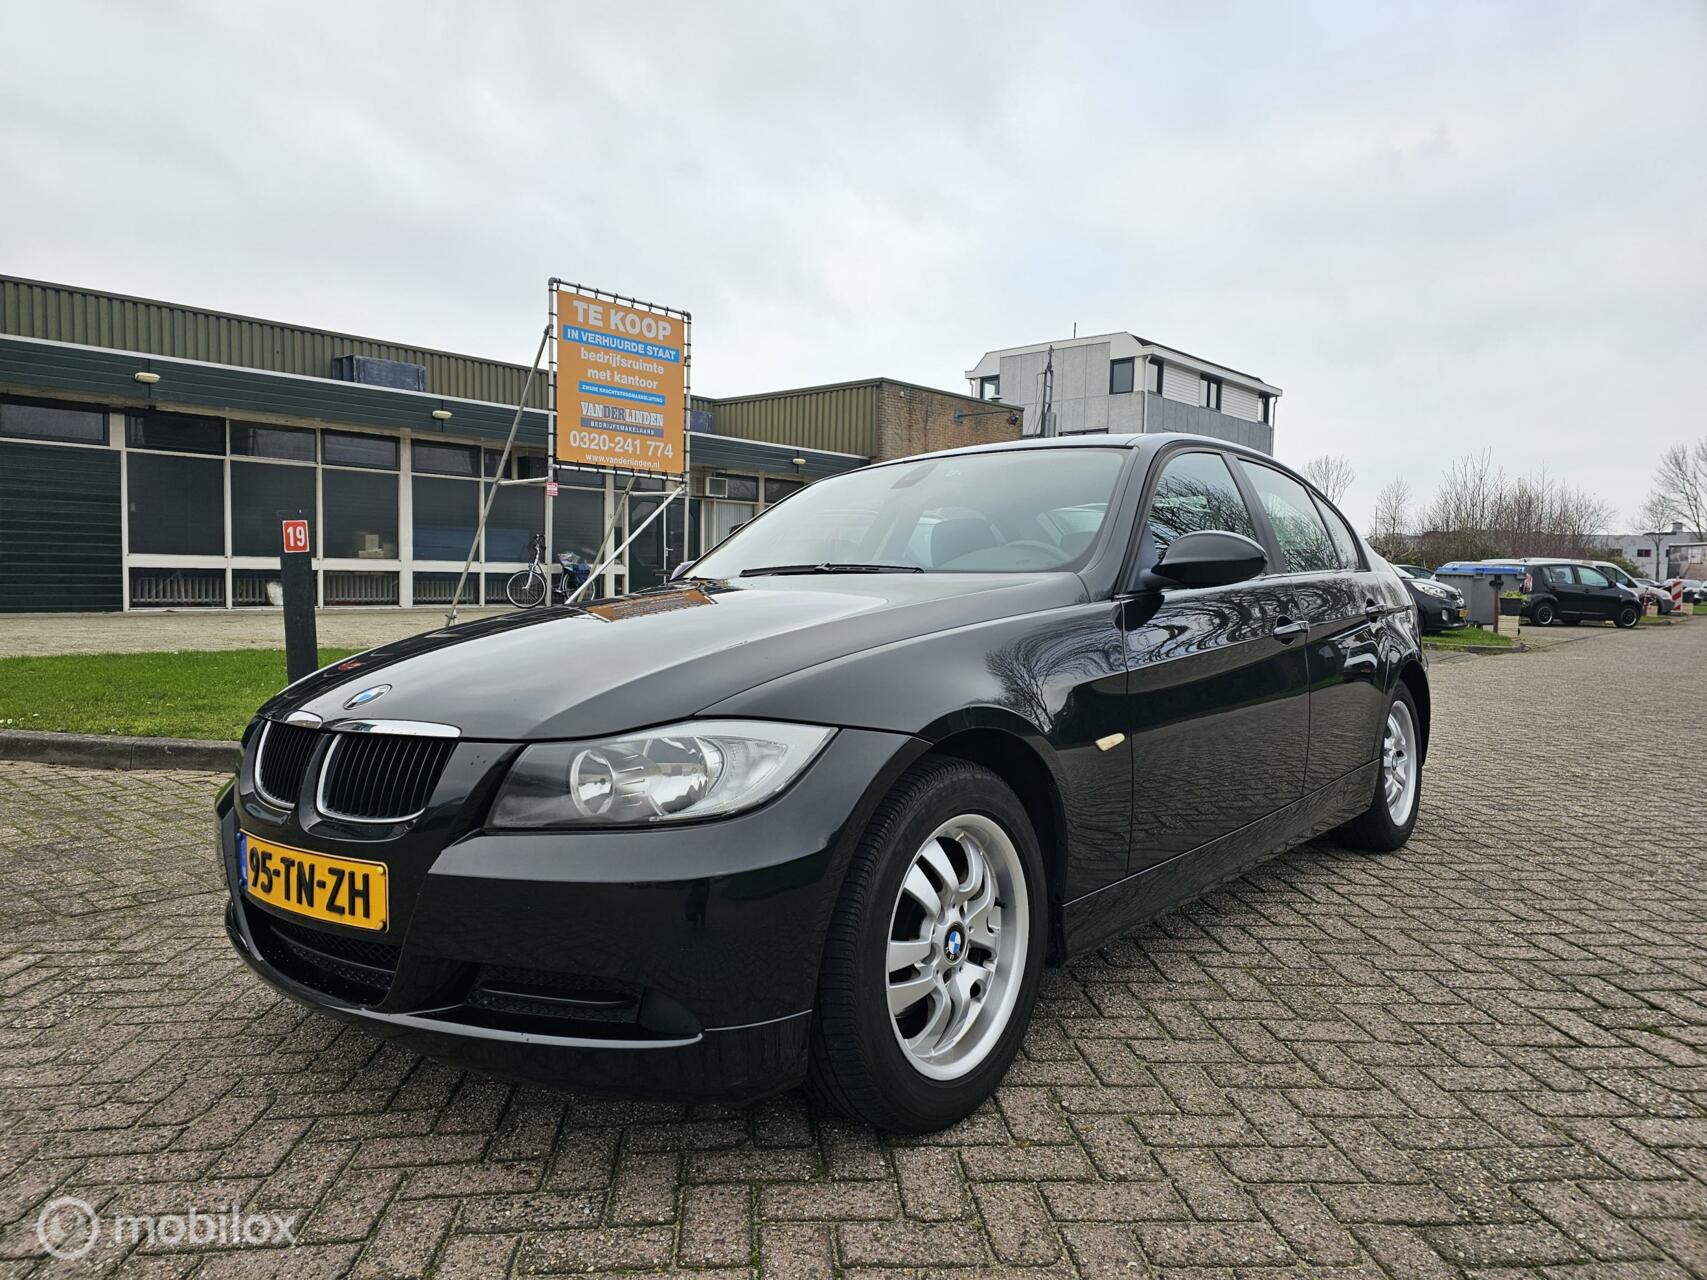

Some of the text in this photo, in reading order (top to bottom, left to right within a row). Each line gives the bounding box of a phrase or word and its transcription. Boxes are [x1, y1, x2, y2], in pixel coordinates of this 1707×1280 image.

[572, 299, 672, 341] TE KOOP
[567, 328, 676, 361] IN VERHUURDE STAAT
[580, 346, 665, 375] bedrijfsruimte
[587, 366, 659, 389] met kantoor
[590, 421, 655, 435] BEDRIJFSMAKELAARS
[569, 430, 673, 459] 0320-241 774
[585, 453, 660, 468] www.vanderlinden.nl
[287, 526, 306, 547] 19
[249, 847, 370, 919] 95-TN-ZH
